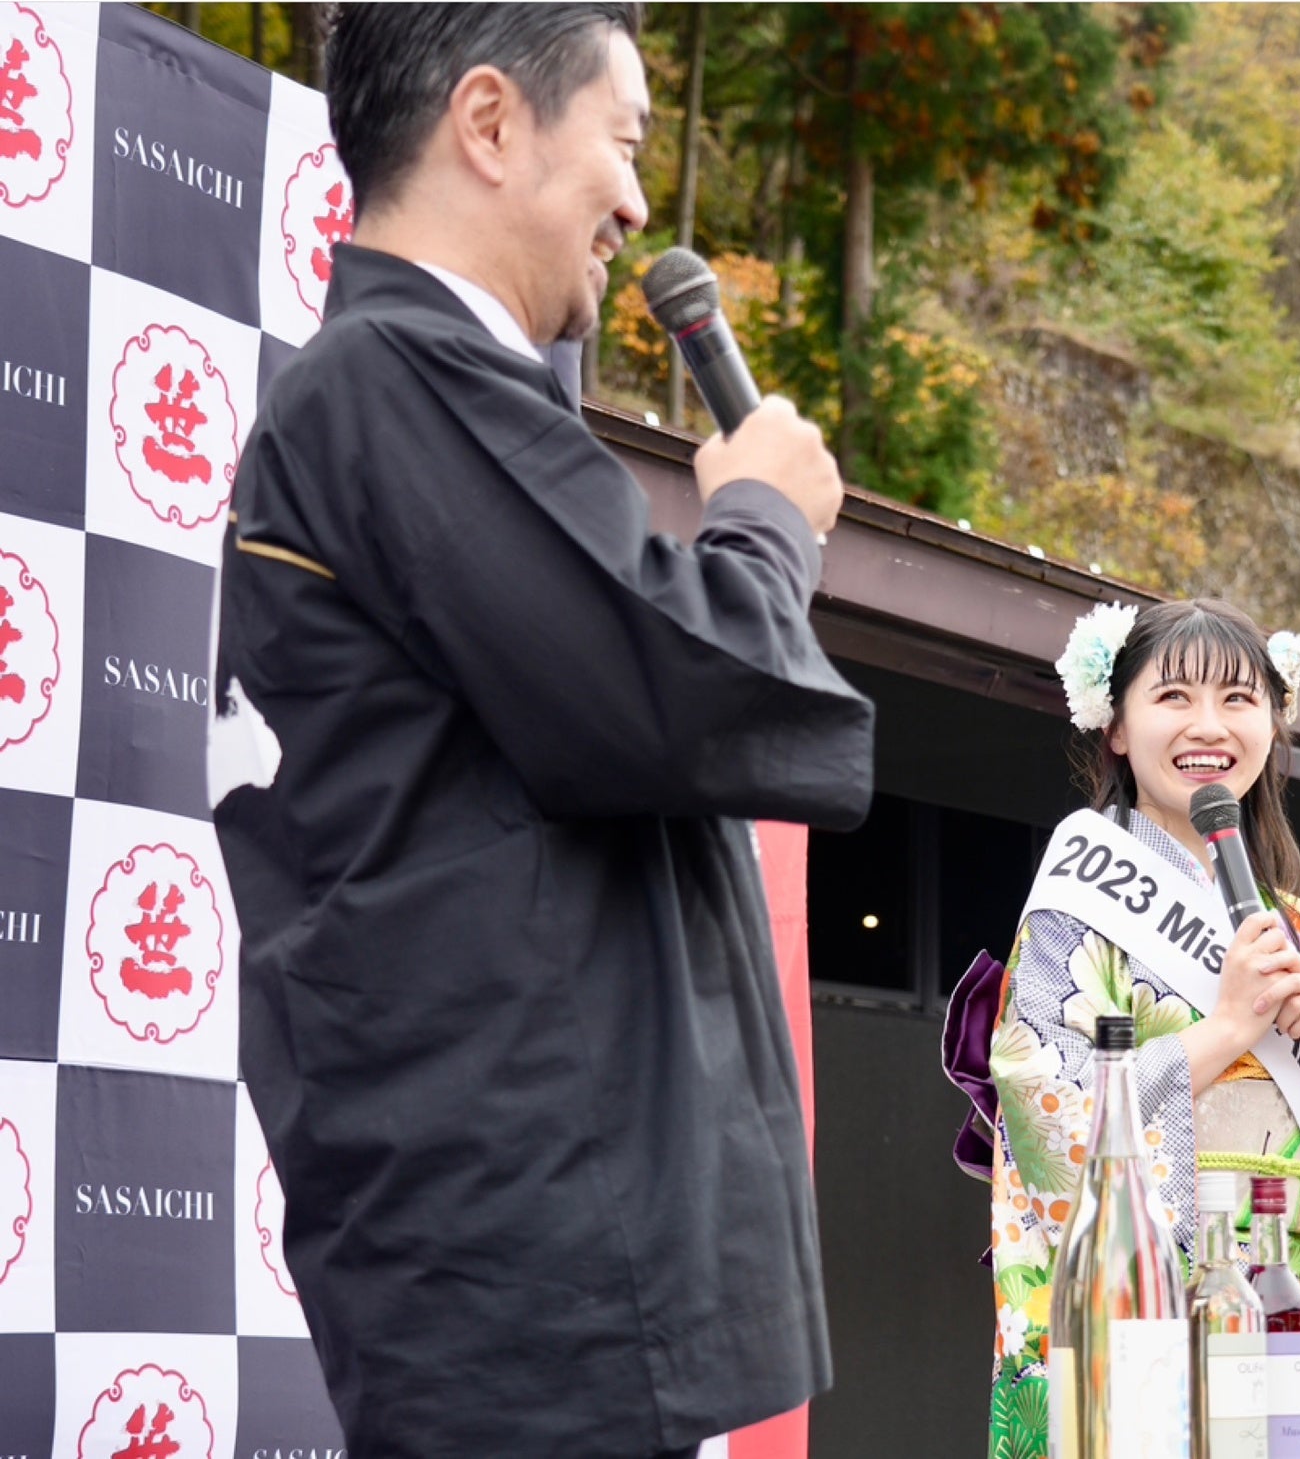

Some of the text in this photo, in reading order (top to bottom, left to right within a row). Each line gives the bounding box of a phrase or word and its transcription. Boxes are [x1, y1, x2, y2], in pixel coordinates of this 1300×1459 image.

[115, 128, 242, 208] SASAICHI
[1048, 834, 1159, 915] 2023
[77, 1185, 213, 1220] SASAICHI
